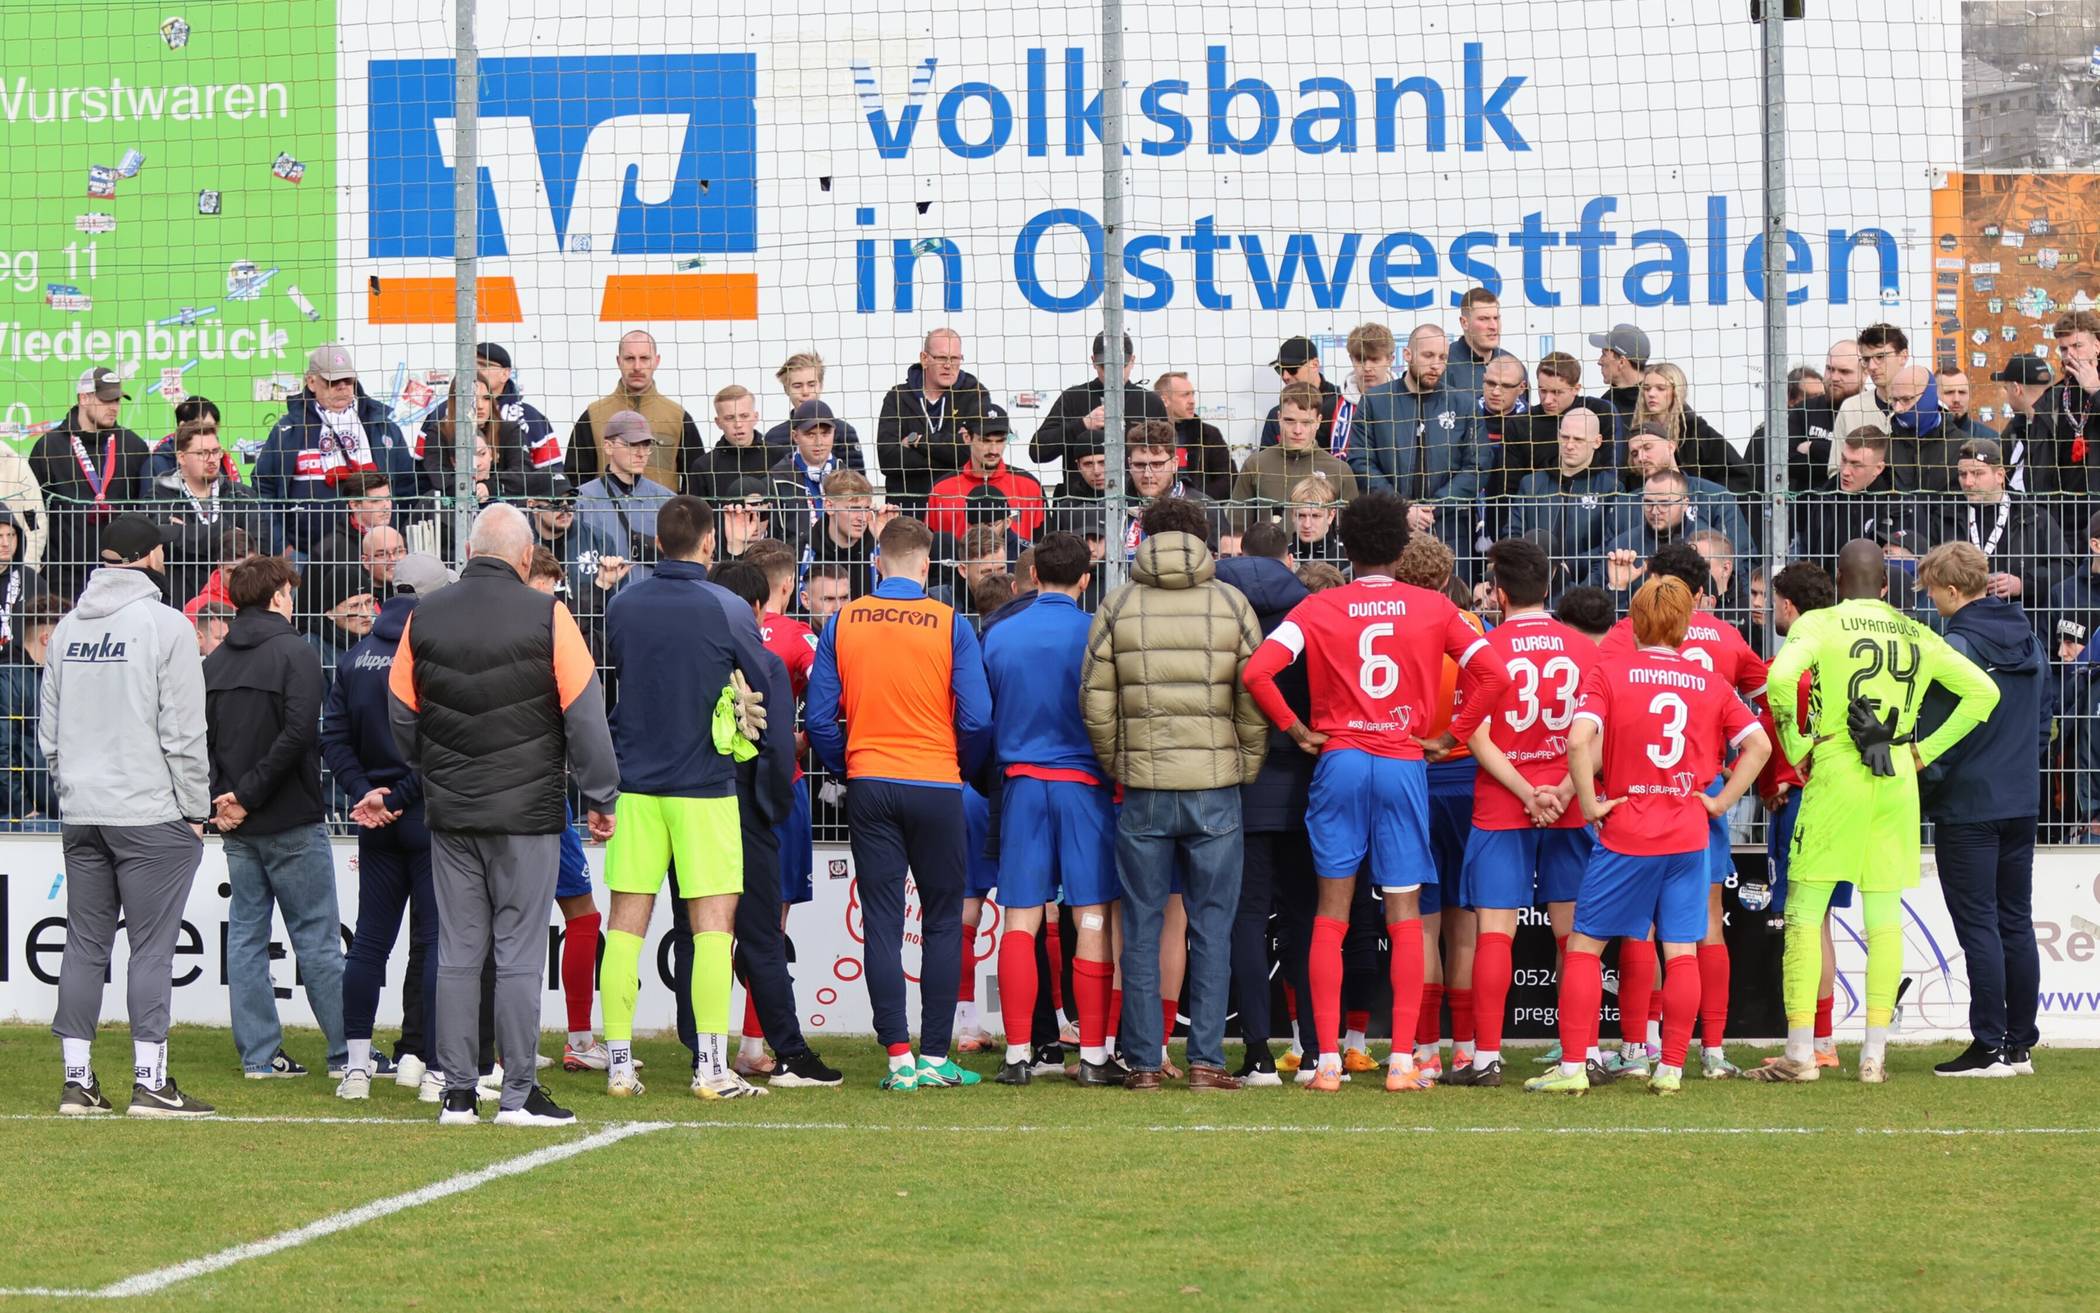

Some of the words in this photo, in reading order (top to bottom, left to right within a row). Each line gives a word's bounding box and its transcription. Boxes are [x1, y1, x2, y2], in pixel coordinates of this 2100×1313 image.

[850, 42, 1533, 159] Volksbank
[62, 241, 97, 279] 11
[856, 207, 964, 313] in
[1014, 195, 1899, 313] Ostwestfalen
[0, 319, 289, 362] iedenbrück
[850, 607, 938, 629] macron
[1349, 601, 1406, 617] DUNCAN
[1841, 618, 1920, 638] LUYAMBULA
[1359, 622, 1399, 699] 6
[1511, 635, 1564, 653] DURGUN
[1505, 656, 1580, 732] 33
[1629, 668, 1706, 691] MIYAMOTO
[1847, 638, 1921, 713] 24
[1646, 692, 1688, 769] 3
